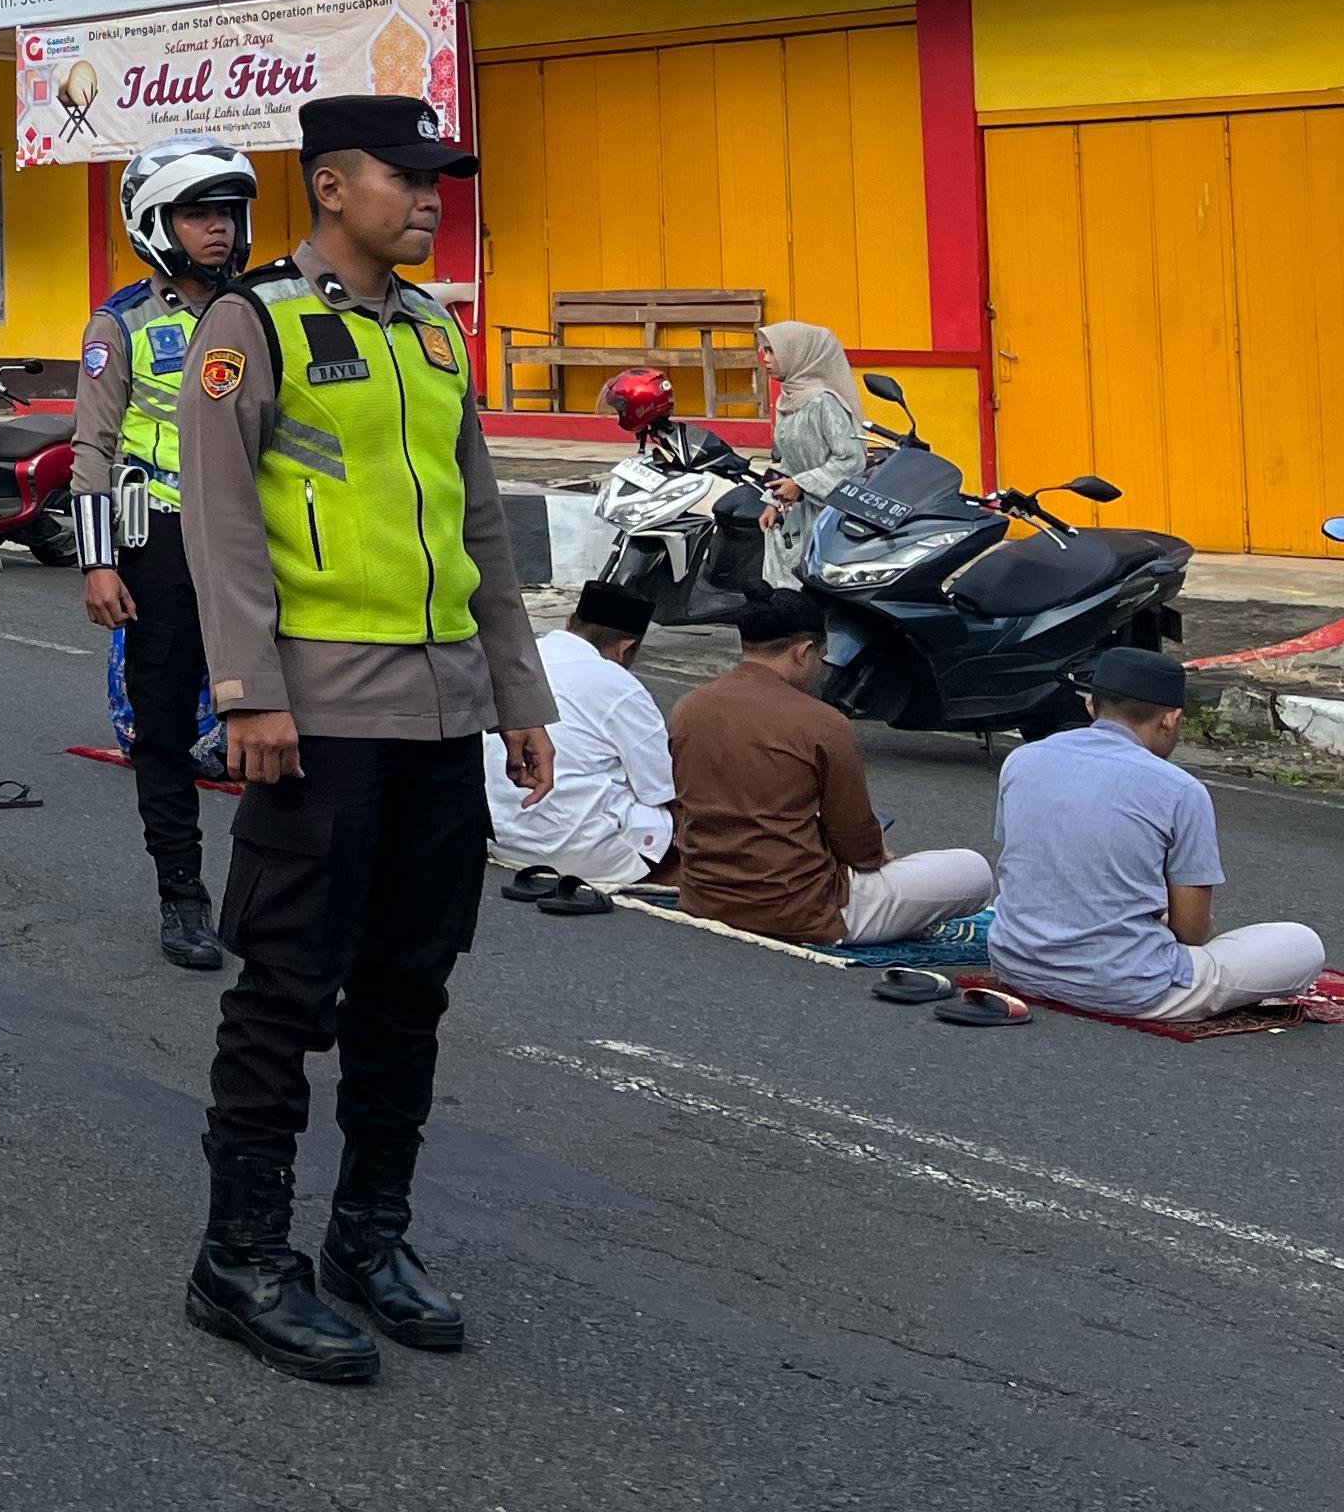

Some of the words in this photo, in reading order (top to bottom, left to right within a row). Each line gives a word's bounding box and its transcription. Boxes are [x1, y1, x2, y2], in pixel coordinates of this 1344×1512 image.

[88, 25, 123, 42] Direksi,
[125, 22, 169, 39] Pengajar,
[172, 19, 190, 32] dan
[193, 15, 213, 30] Staf
[216, 10, 259, 28] Ganesha
[261, 6, 314, 25] Operation
[164, 37, 209, 55] Selamat
[212, 33, 241, 49] Hari
[243, 31, 275, 50] Raya
[116, 58, 214, 109] Idul
[224, 51, 318, 101] Fitri
[147, 108, 179, 125] Mohon
[181, 106, 212, 124] Maaf
[214, 104, 241, 120] Lahir
[243, 103, 262, 118] dan
[318, 365, 358, 381] BAYU
[840, 484, 860, 498] AD
